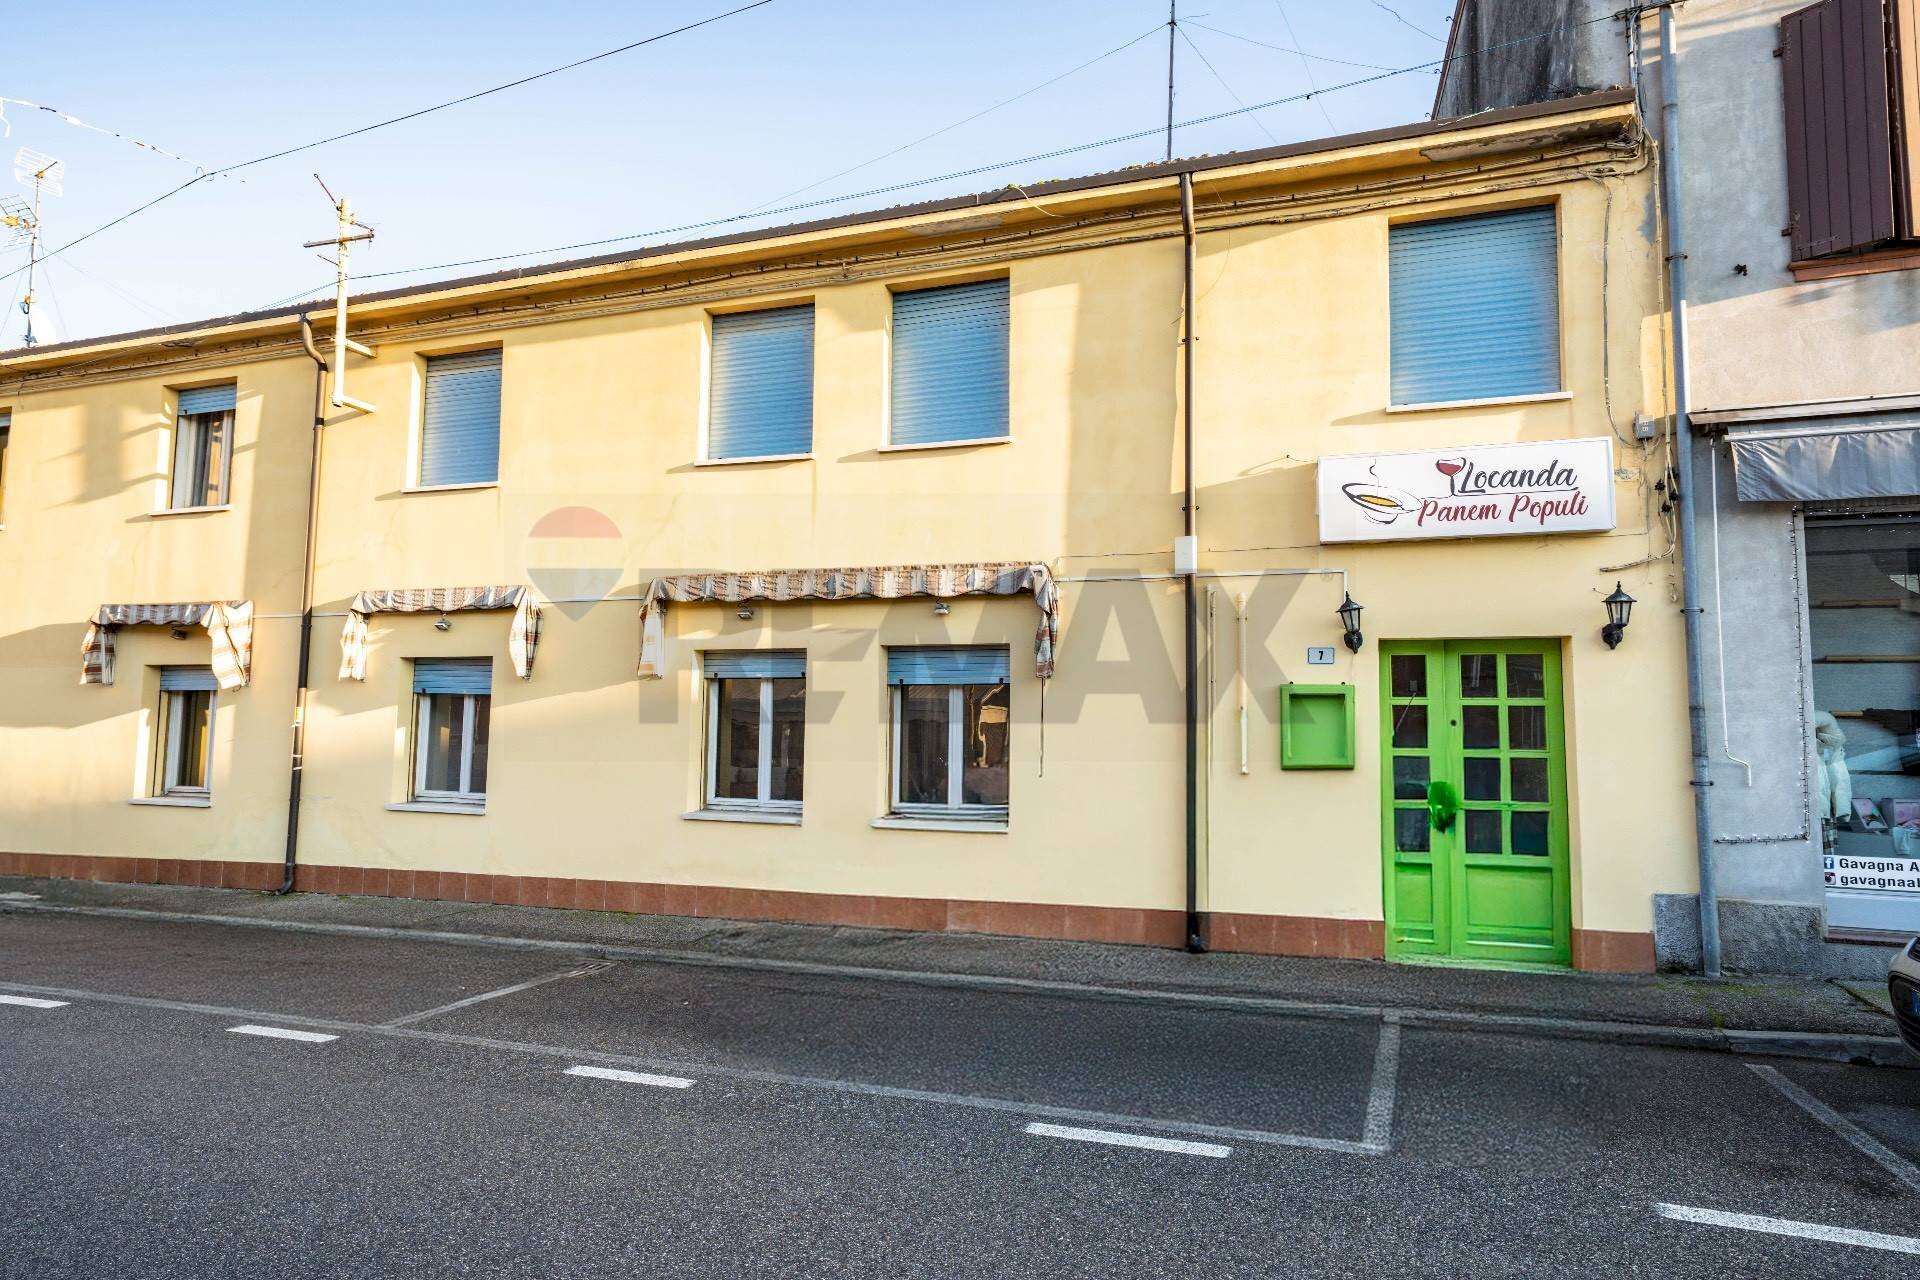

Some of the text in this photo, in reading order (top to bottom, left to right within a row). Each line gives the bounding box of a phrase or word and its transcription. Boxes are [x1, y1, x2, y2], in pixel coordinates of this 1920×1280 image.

[1458, 459, 1578, 493] Locanda
[1417, 491, 1589, 527] Panem Populi
[1318, 650, 1324, 661] 7
[1839, 858, 1904, 872] Gavagna
